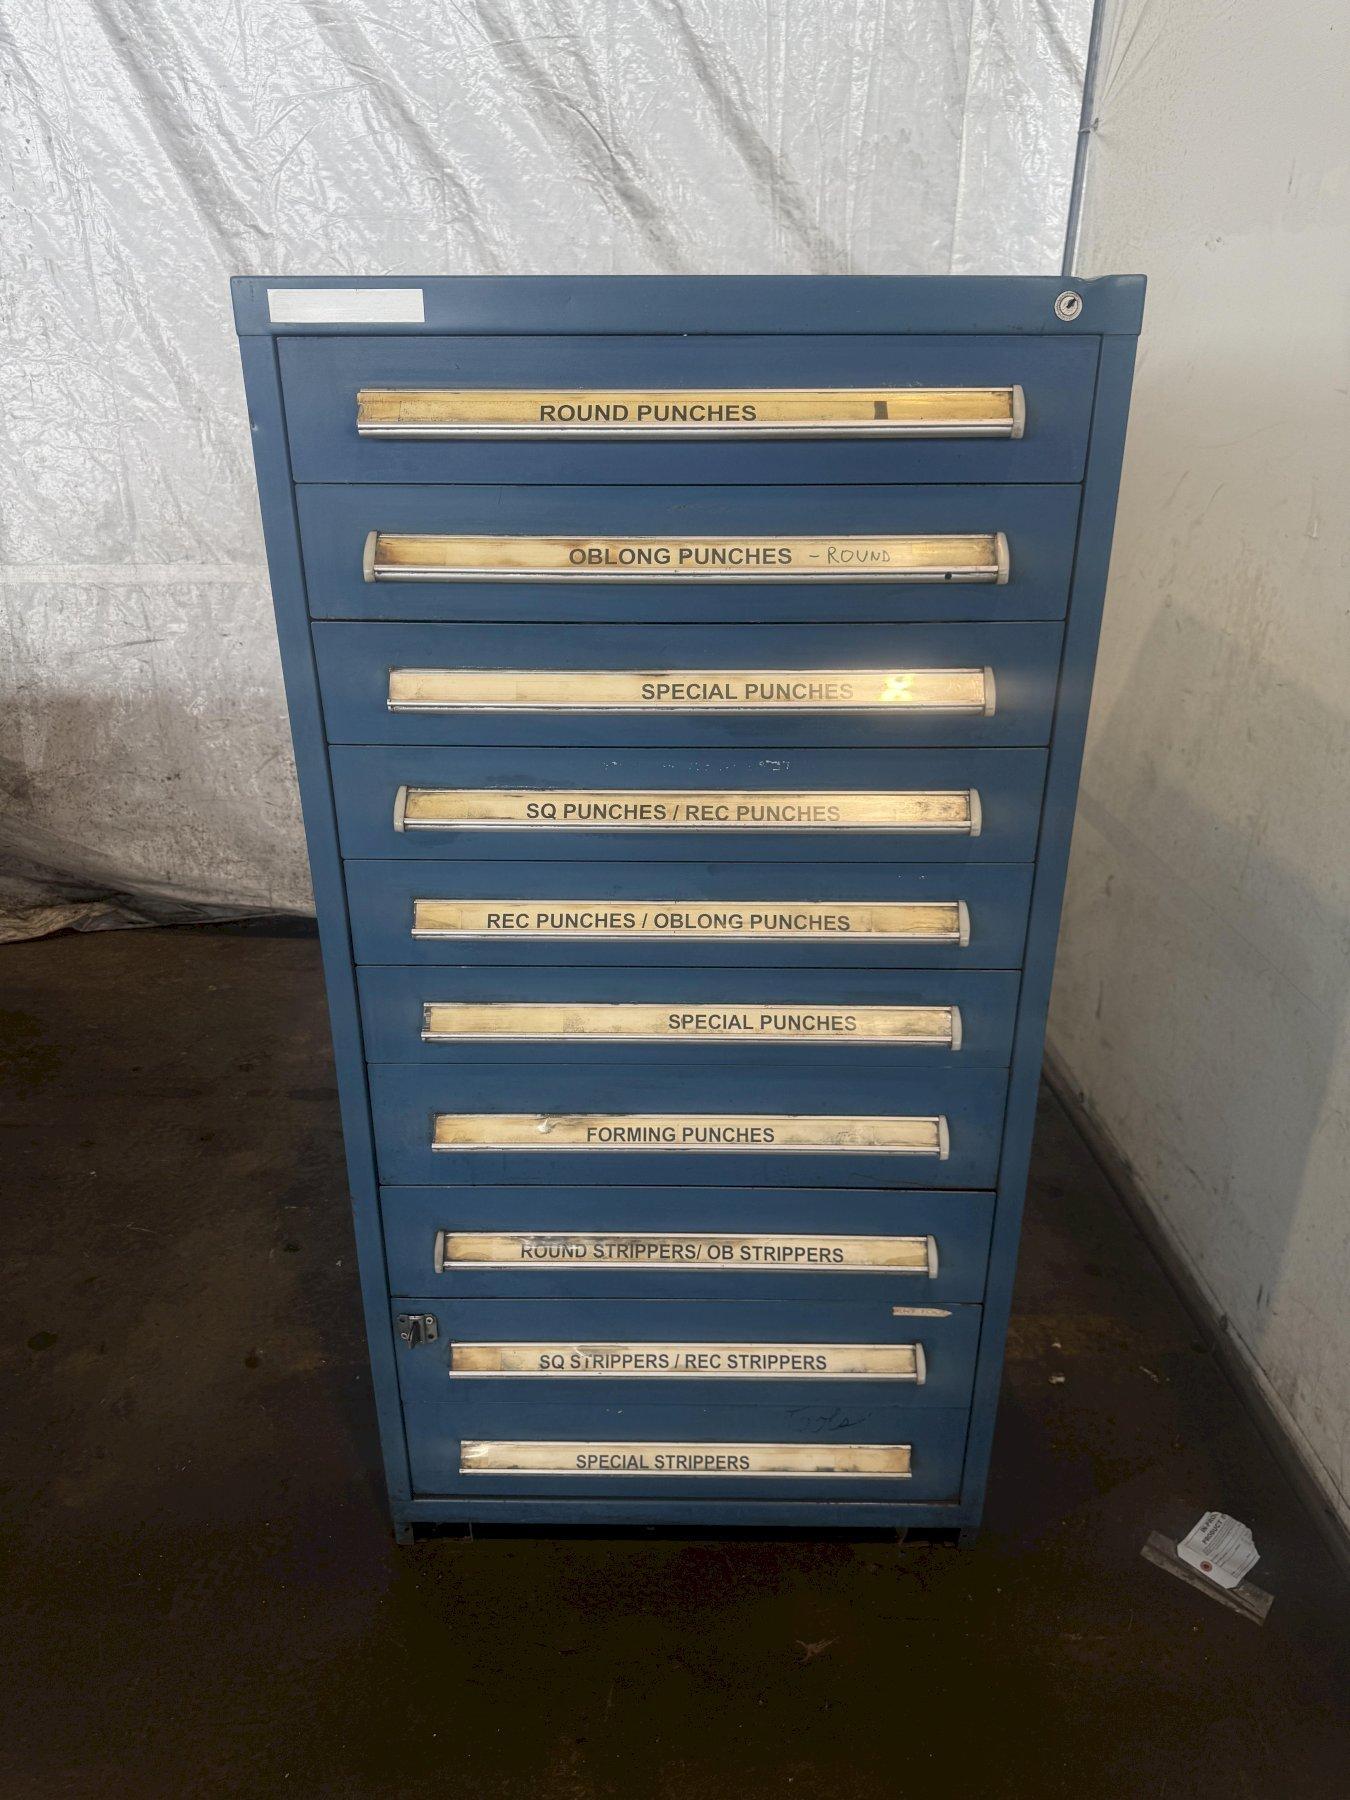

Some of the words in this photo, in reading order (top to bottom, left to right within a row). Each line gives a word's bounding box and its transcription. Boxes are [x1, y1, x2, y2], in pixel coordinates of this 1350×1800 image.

[540, 405, 629, 421] ROUND
[637, 405, 757, 421] PUNCHES
[569, 548, 671, 565] OBLONG
[679, 548, 792, 565] PUNCHES
[827, 547, 890, 563] ROUND
[641, 683, 737, 700] SPECIAL
[745, 683, 853, 700] PUNCHES
[526, 803, 556, 820] SQ
[564, 804, 666, 820] PUNCHES
[686, 805, 729, 821] REC
[737, 805, 840, 822] PUNCHES
[487, 913, 530, 929] REC
[537, 913, 635, 929] PUNCHES
[654, 914, 743, 929] OBLONG
[750, 914, 850, 931] PUNCHES
[668, 1014, 753, 1030] SPECIAL
[761, 1014, 857, 1031] PUNCHES
[587, 1127, 676, 1142] FORMING
[683, 1127, 774, 1143] PUNCHES
[521, 1244, 587, 1259] ROUND
[708, 1245, 733, 1260] OB
[740, 1246, 843, 1263] STRIPPERS
[540, 1355, 565, 1370] SQ
[570, 1354, 669, 1369] STRIPPERS
[685, 1354, 721, 1369] REC
[727, 1355, 827, 1370] STRIPPERS
[576, 1455, 649, 1469] SPECIAL
[654, 1455, 749, 1471] STRIPPERS
[1202, 1520, 1222, 1544] PRODUCT
